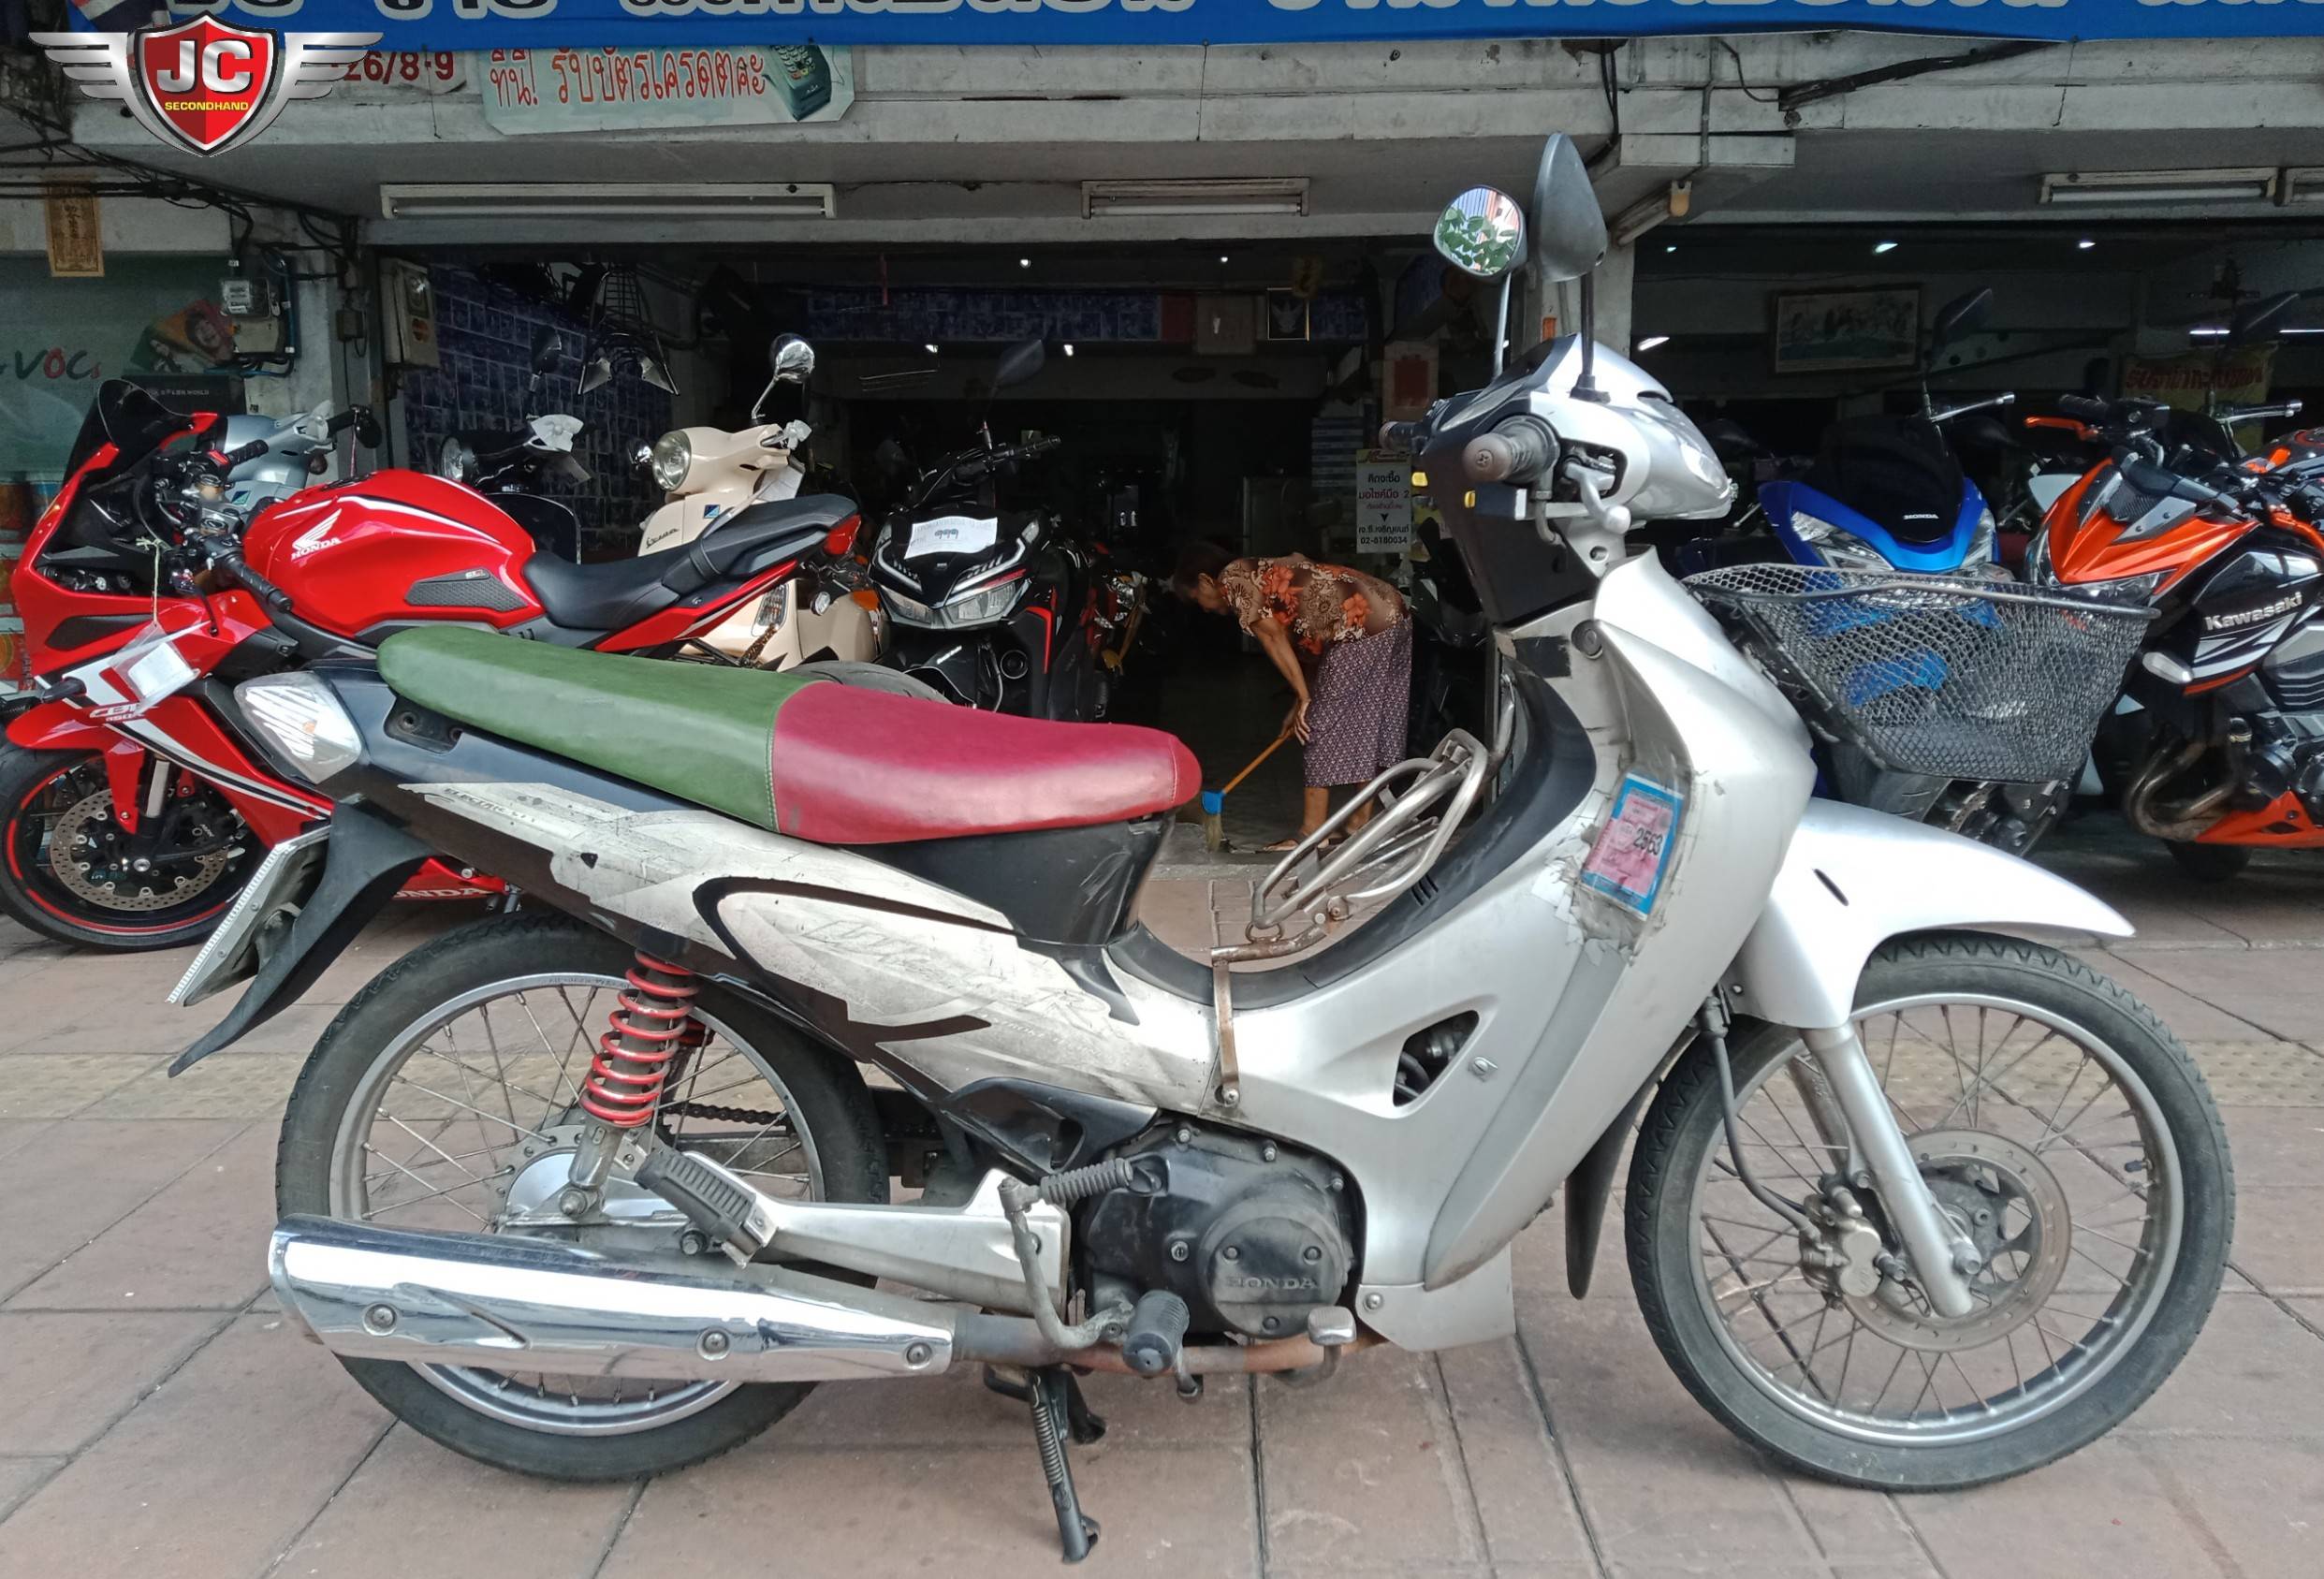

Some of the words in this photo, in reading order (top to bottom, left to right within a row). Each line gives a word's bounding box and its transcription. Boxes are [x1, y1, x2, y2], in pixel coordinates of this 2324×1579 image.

[291, 537, 343, 562] HONDA
[2203, 591, 2303, 631] Kawasaki
[1633, 827, 1664, 856] 2563
[1225, 1277, 1319, 1291] HONDA
